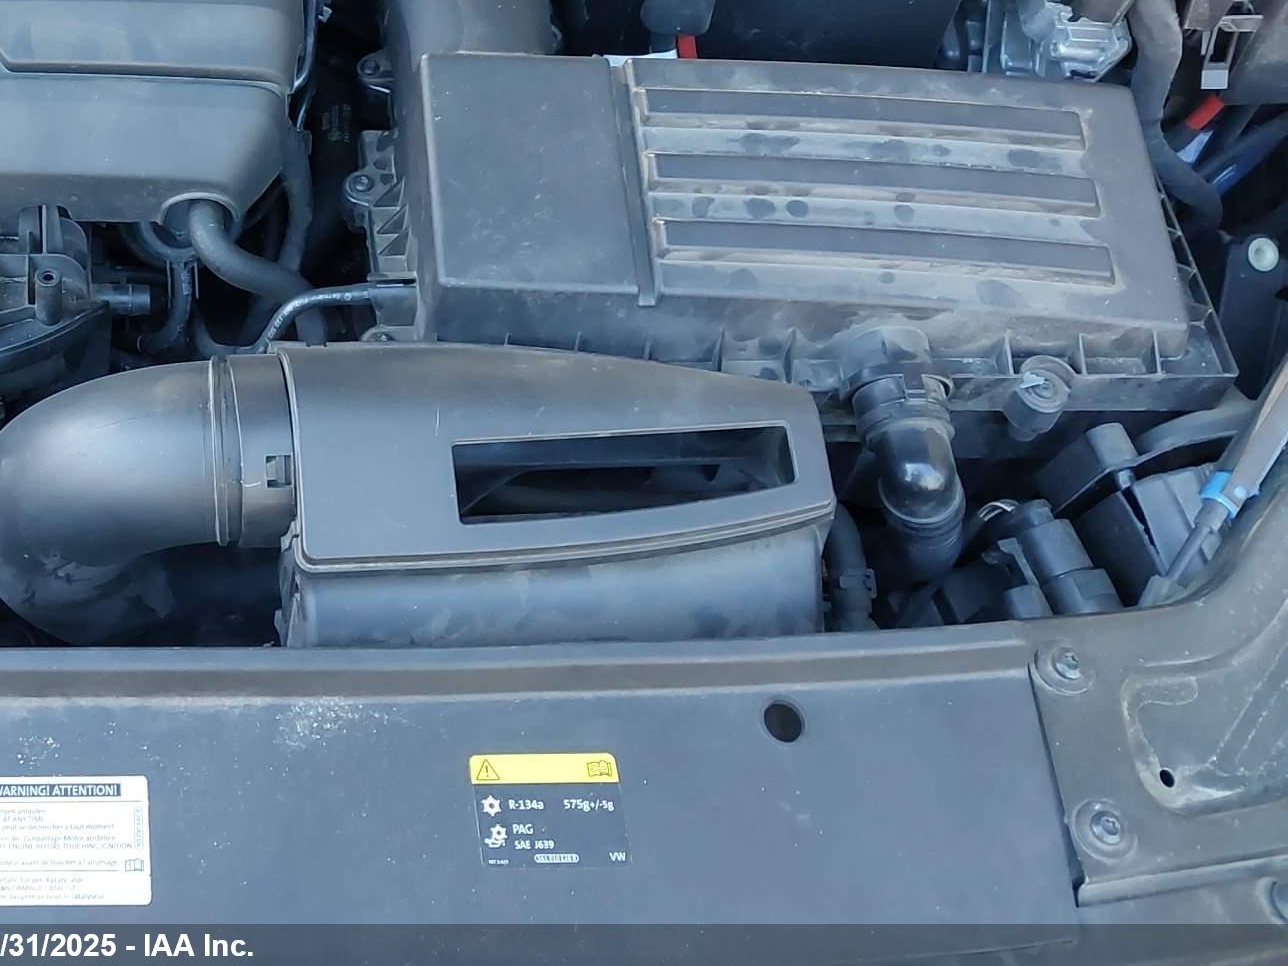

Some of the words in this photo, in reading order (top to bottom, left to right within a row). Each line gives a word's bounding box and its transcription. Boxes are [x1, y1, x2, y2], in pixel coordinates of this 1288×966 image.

[51, 784, 118, 796] ATTENTION!
[508, 799, 544, 810] R-134a
[563, 798, 615, 812] 575g+/-5g
[512, 823, 534, 835] PAG
[514, 840, 531, 850] SAE
[534, 839, 555, 850] J639
[609, 851, 626, 862] VW
